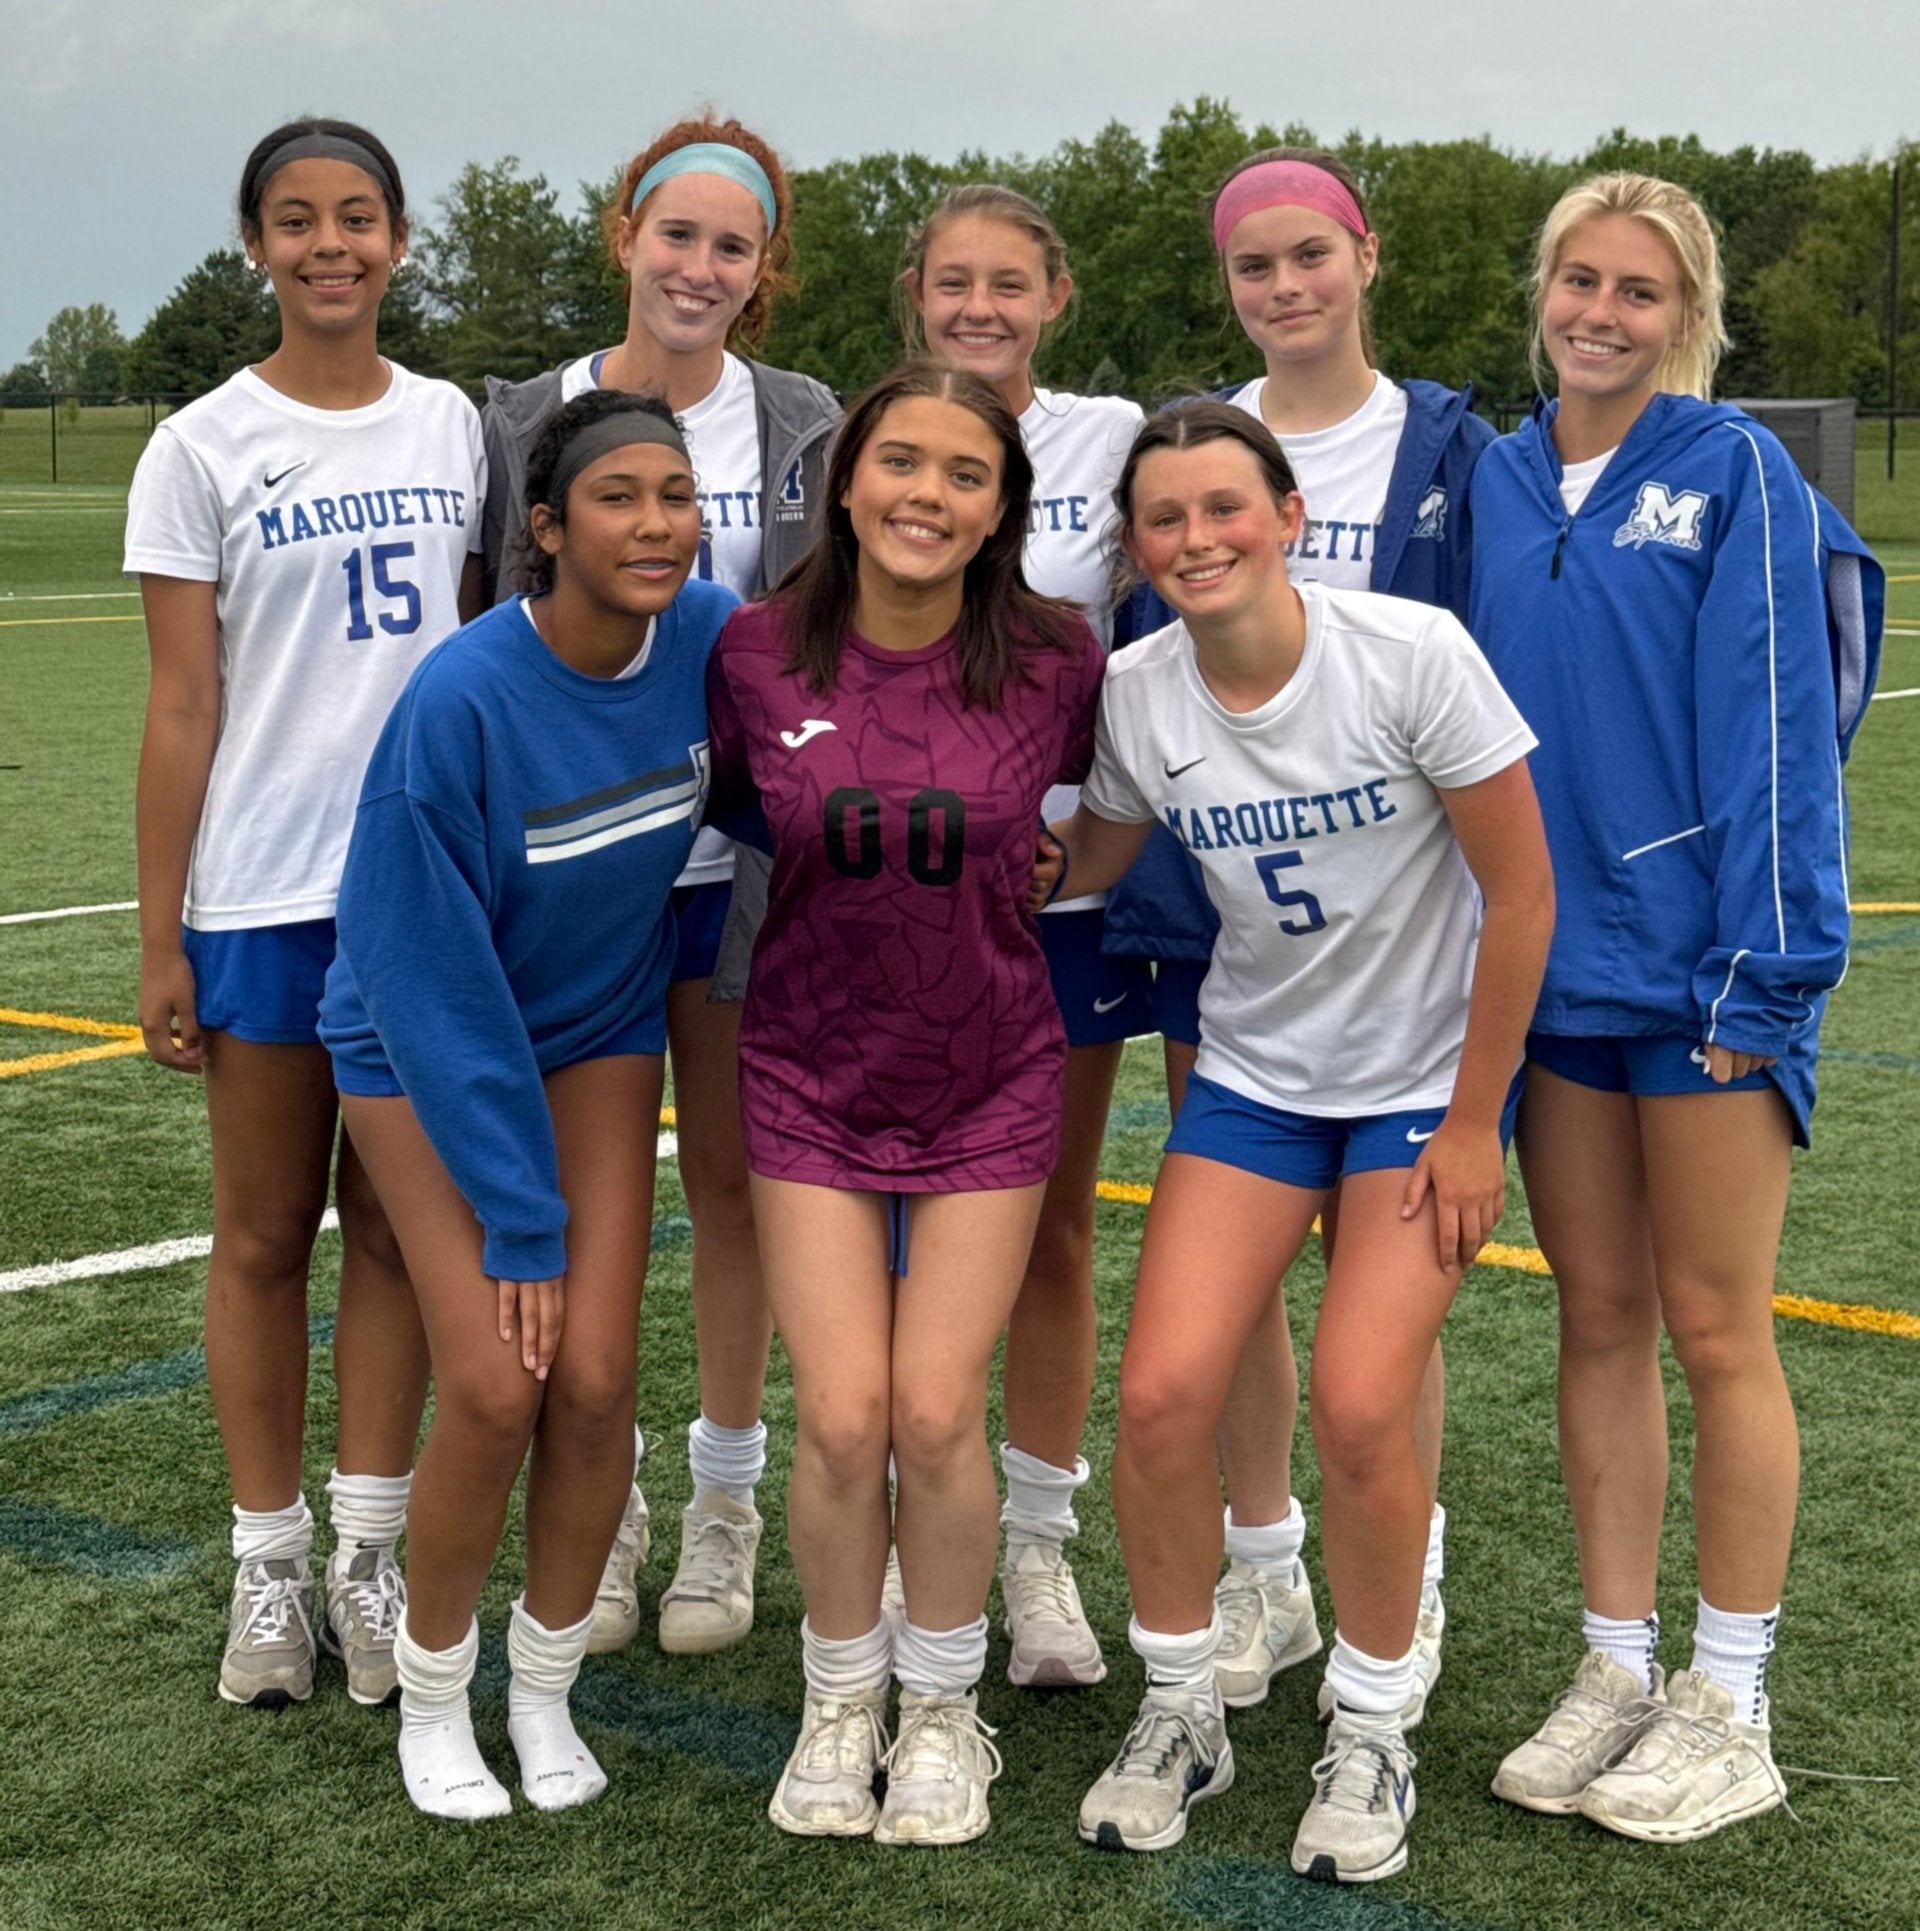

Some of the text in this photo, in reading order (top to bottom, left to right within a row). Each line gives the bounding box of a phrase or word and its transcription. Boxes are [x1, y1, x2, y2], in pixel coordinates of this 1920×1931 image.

[256, 487, 466, 550] MARQUETTE
[342, 541, 422, 641] 15
[824, 786, 966, 887] 00
[1164, 777, 1397, 850] MARQUETTE
[1254, 849, 1328, 936] 5
